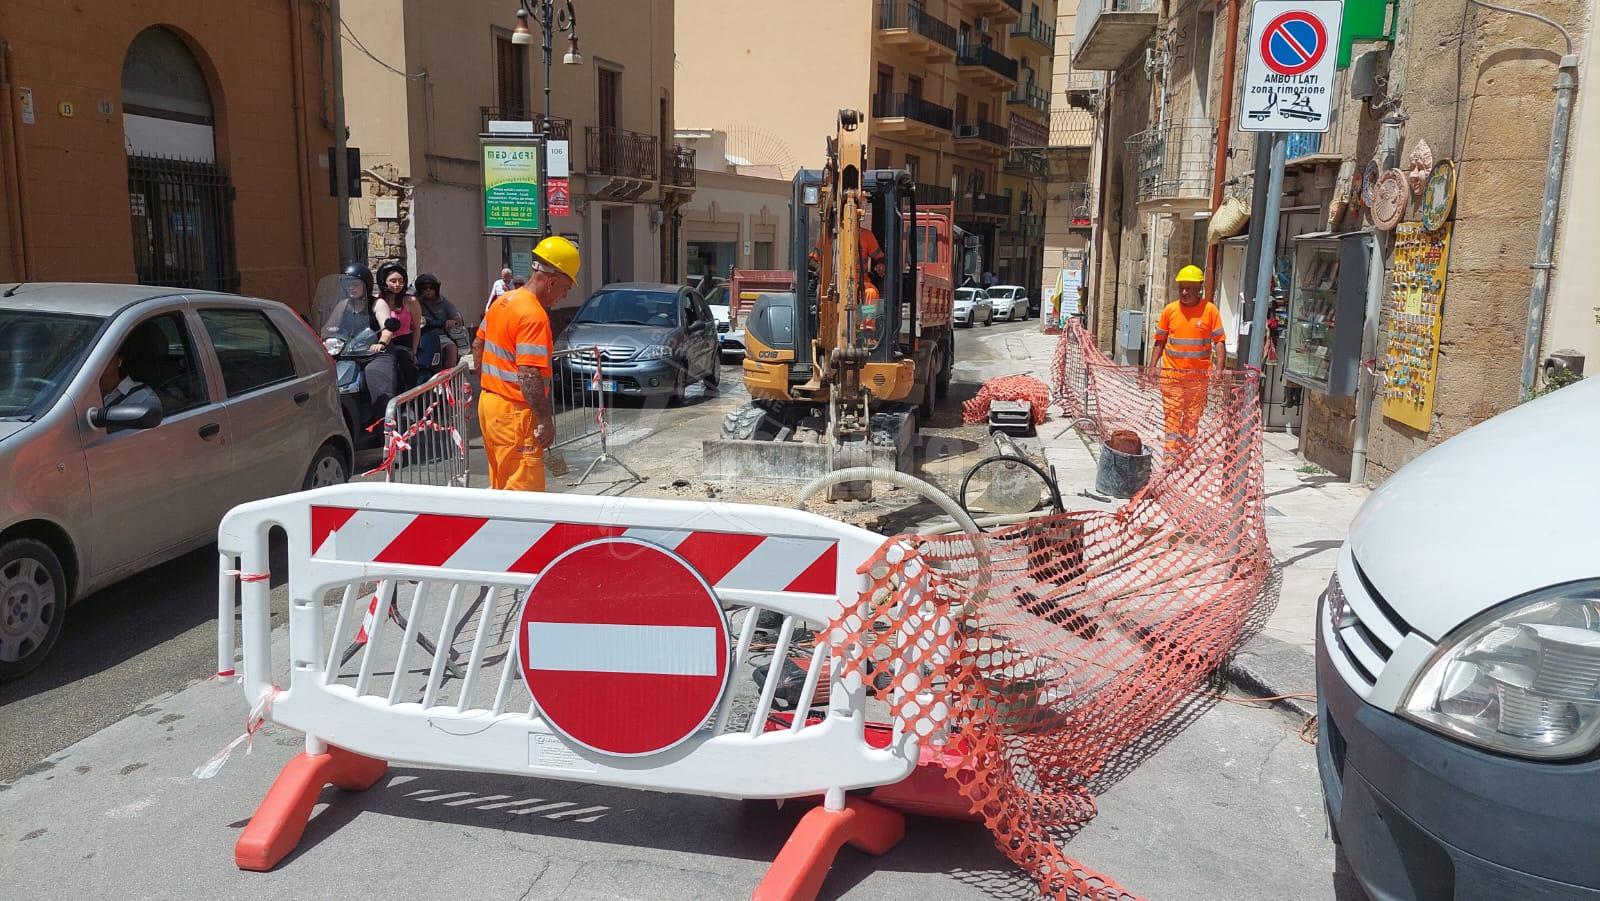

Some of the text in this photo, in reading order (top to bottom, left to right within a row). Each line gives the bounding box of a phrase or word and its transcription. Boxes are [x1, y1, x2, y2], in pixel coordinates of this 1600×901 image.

[1264, 74, 1290, 83] AMBO
[1299, 75, 1318, 84] LATI
[1251, 84, 1325, 94] zona rimozione
